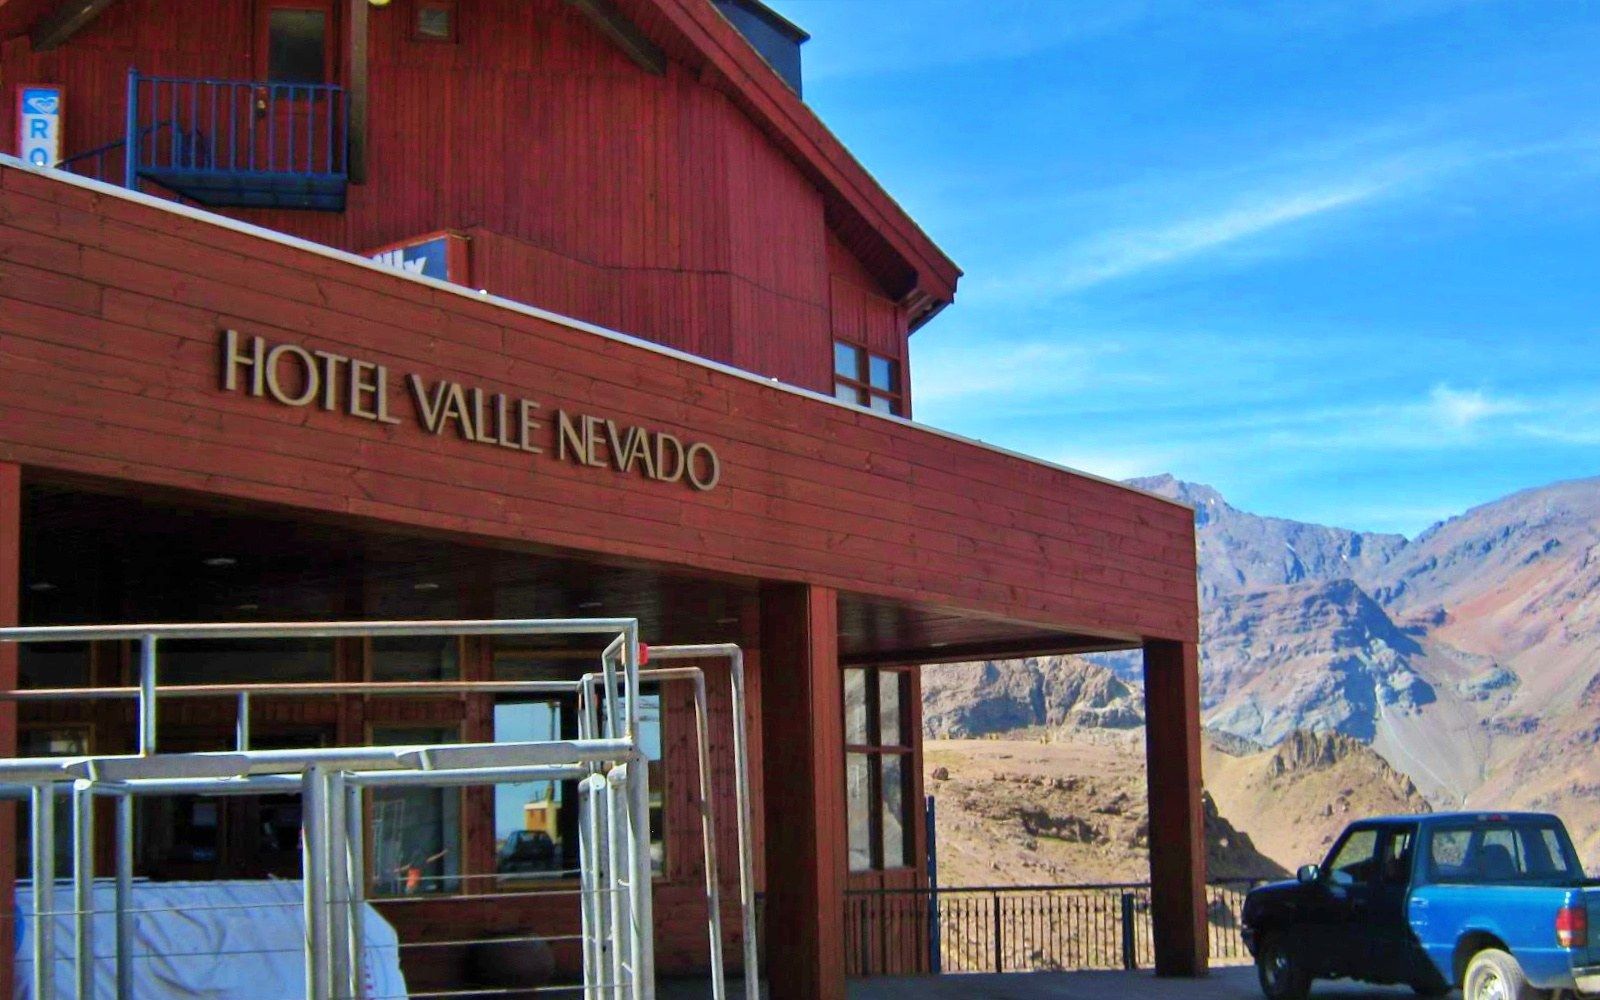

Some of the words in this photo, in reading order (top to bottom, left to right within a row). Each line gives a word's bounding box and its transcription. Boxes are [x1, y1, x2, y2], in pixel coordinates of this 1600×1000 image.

[223, 329, 401, 425] HOTEL
[407, 373, 543, 454] VALLE
[555, 409, 721, 491] NEVADO
